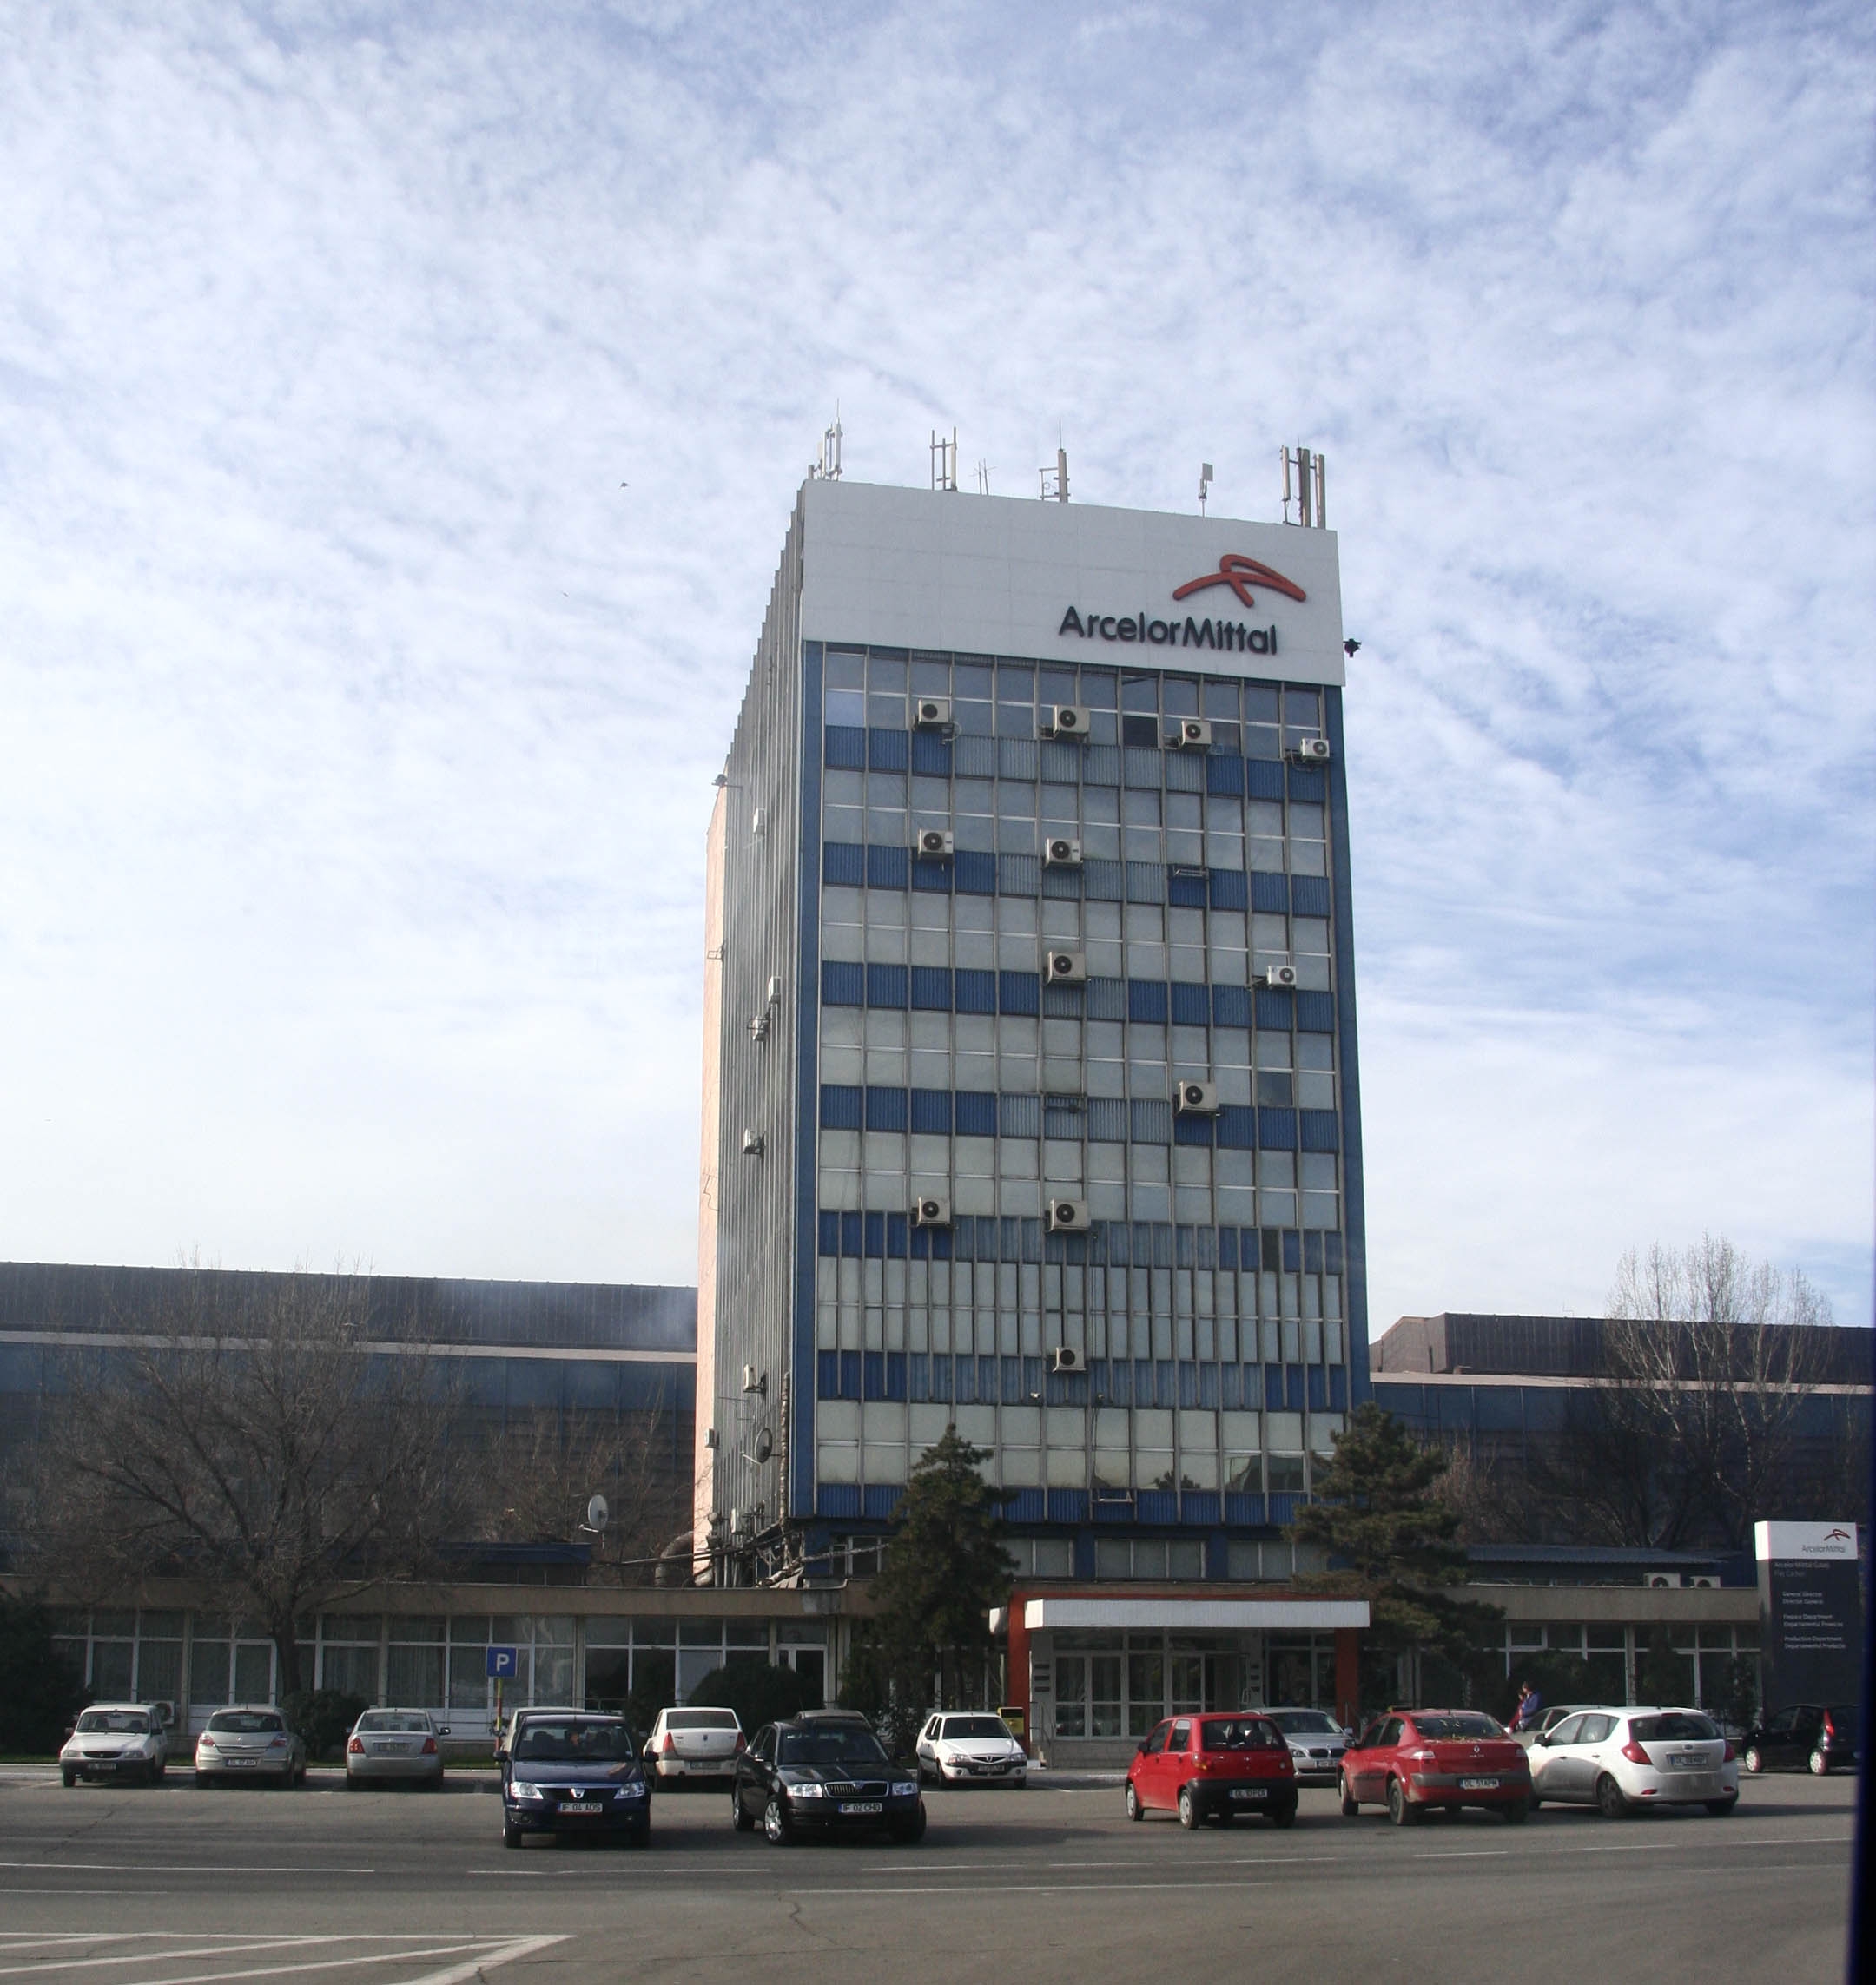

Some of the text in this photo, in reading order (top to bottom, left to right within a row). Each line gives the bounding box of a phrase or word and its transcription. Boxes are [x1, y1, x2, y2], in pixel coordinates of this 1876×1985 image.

[1059, 606, 1278, 656] ArcelorMittal
[1801, 1545, 1846, 1553] ArcelorMittal
[496, 1652, 510, 1672] P
